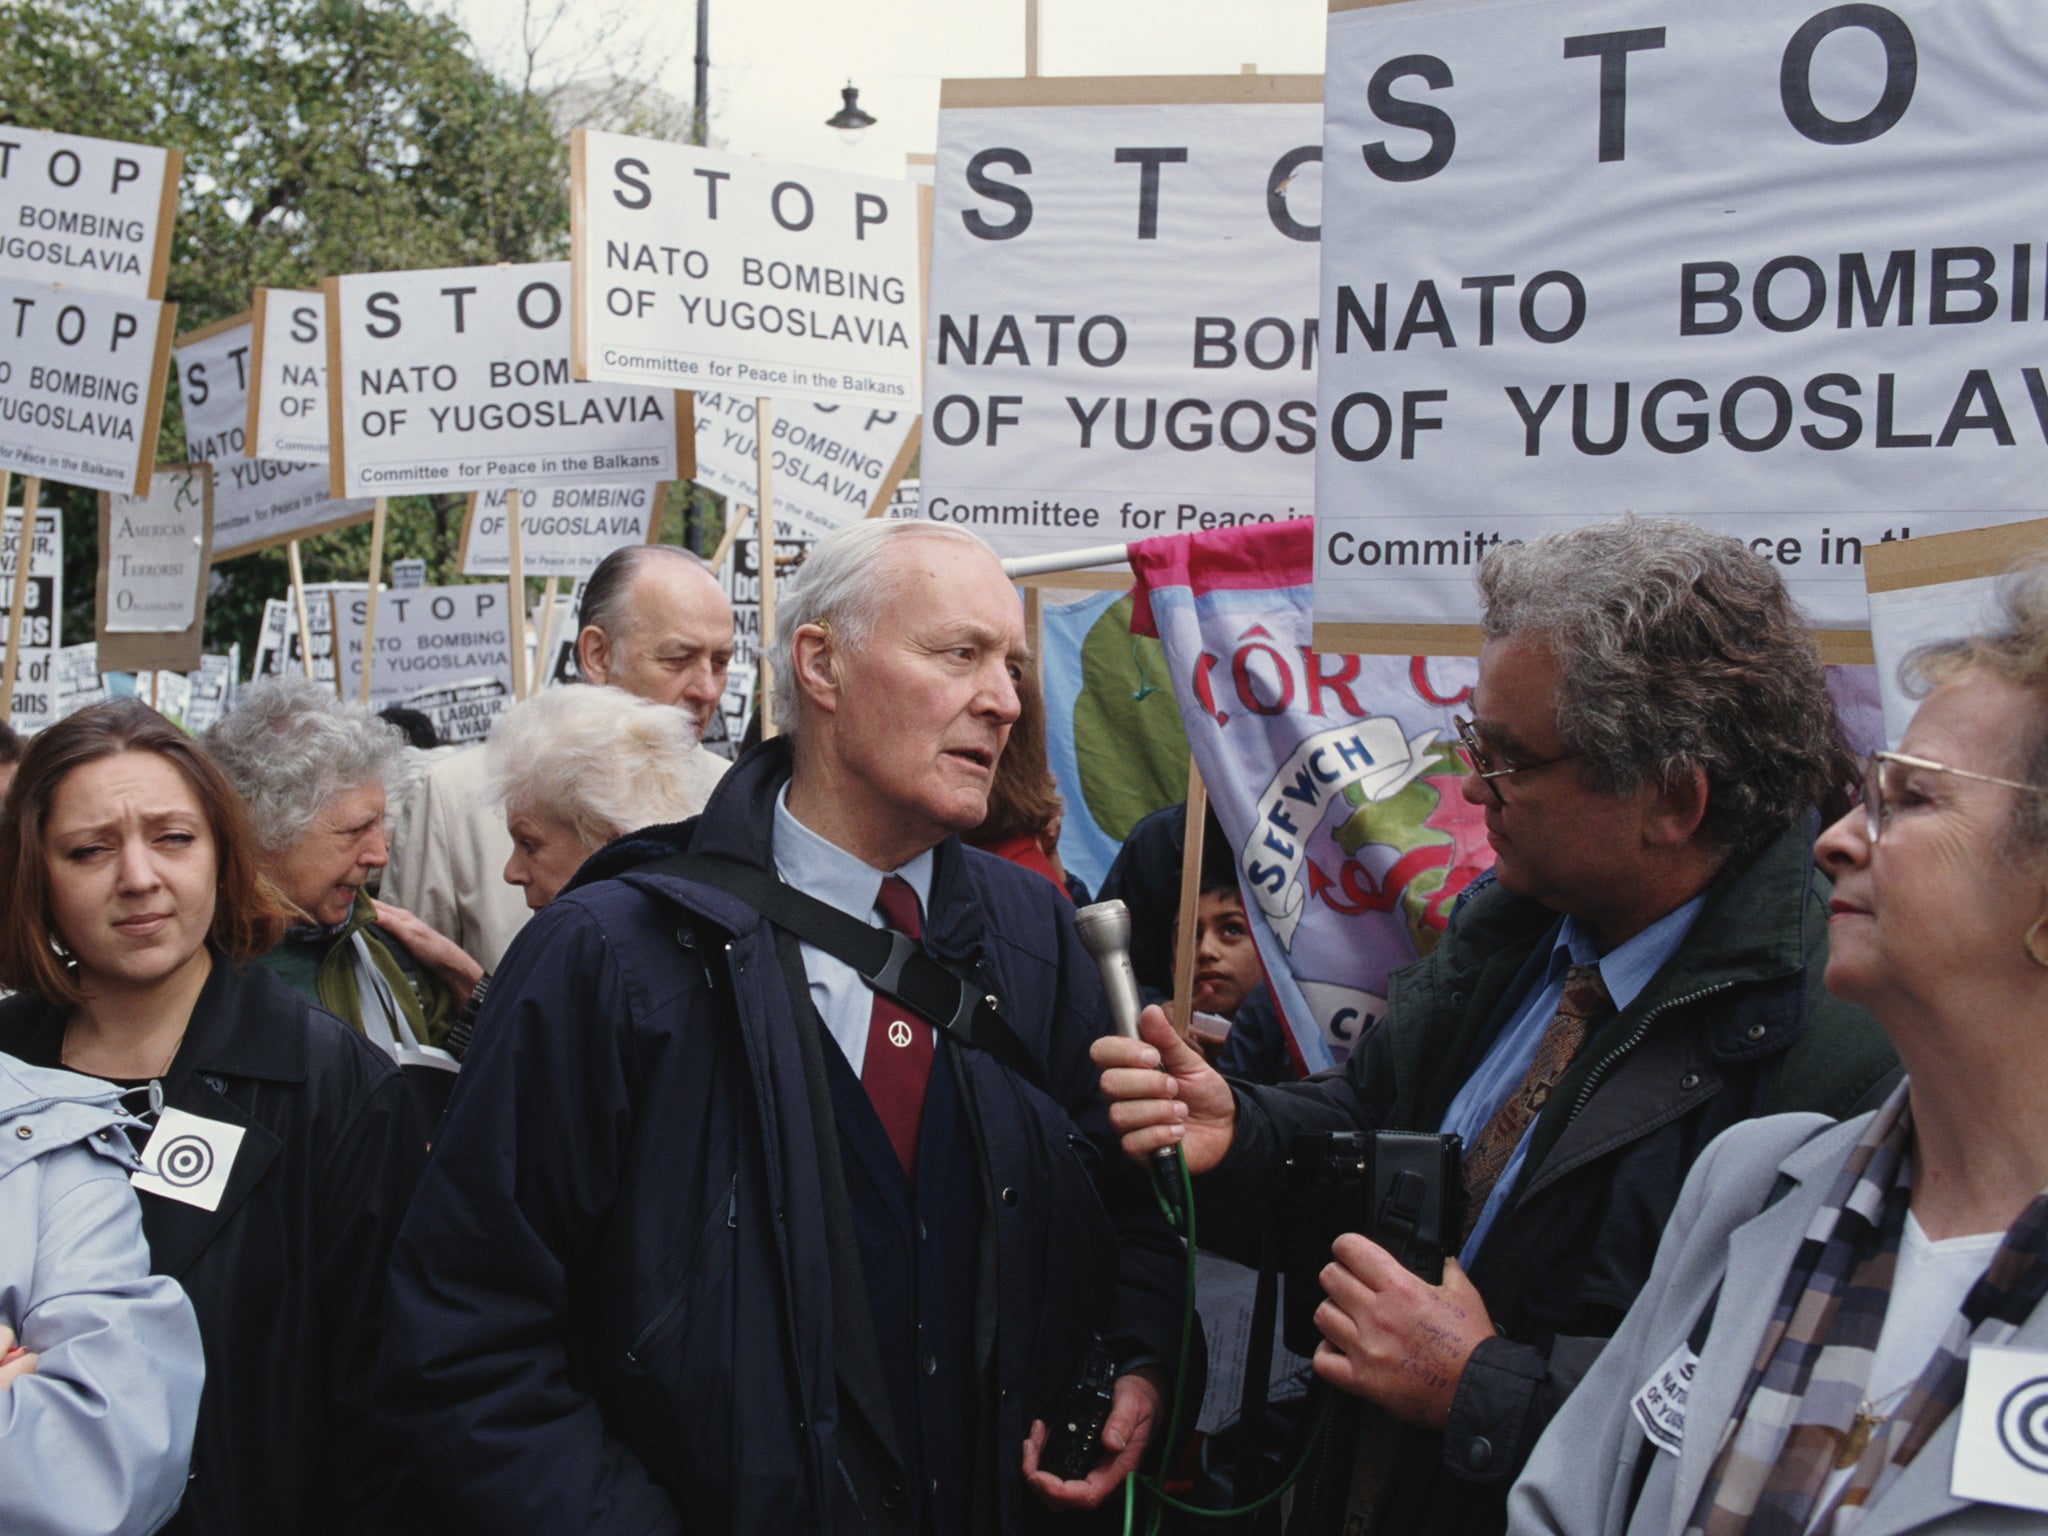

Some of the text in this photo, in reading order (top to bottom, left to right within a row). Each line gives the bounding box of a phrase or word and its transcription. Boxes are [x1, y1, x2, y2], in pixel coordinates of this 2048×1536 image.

[19, 205, 144, 243] BOMBING
[607, 240, 905, 305] NATO BOMBING
[1335, 243, 2048, 354] NATO BOMBI
[607, 287, 909, 350] OF YUGOSLAVIA
[937, 314, 1127, 367] NATO
[30, 366, 138, 405] BOMBING
[282, 363, 327, 388] NA
[361, 358, 592, 396] NATO BOM
[604, 351, 905, 398] Committee for Peace in the Balkans
[280, 396, 315, 418] OF
[362, 396, 665, 437] OF YUGOSLAVIA
[932, 394, 1023, 447] OF
[1065, 397, 1316, 454] YUGOS
[1331, 389, 1448, 462] OF
[189, 427, 245, 462] NATO
[772, 418, 884, 480] BOMBING
[361, 453, 660, 482] Committee for Peace in the Balkans
[485, 488, 646, 508] NAO BOMBING
[928, 497, 1100, 528] Committee
[1120, 502, 1166, 529] for
[480, 516, 507, 535] OF
[1328, 531, 1512, 566] Commit
[1820, 528, 1862, 565] in
[350, 630, 506, 652] NTO BOMBING
[387, 652, 508, 672] YUGOSLAVIA
